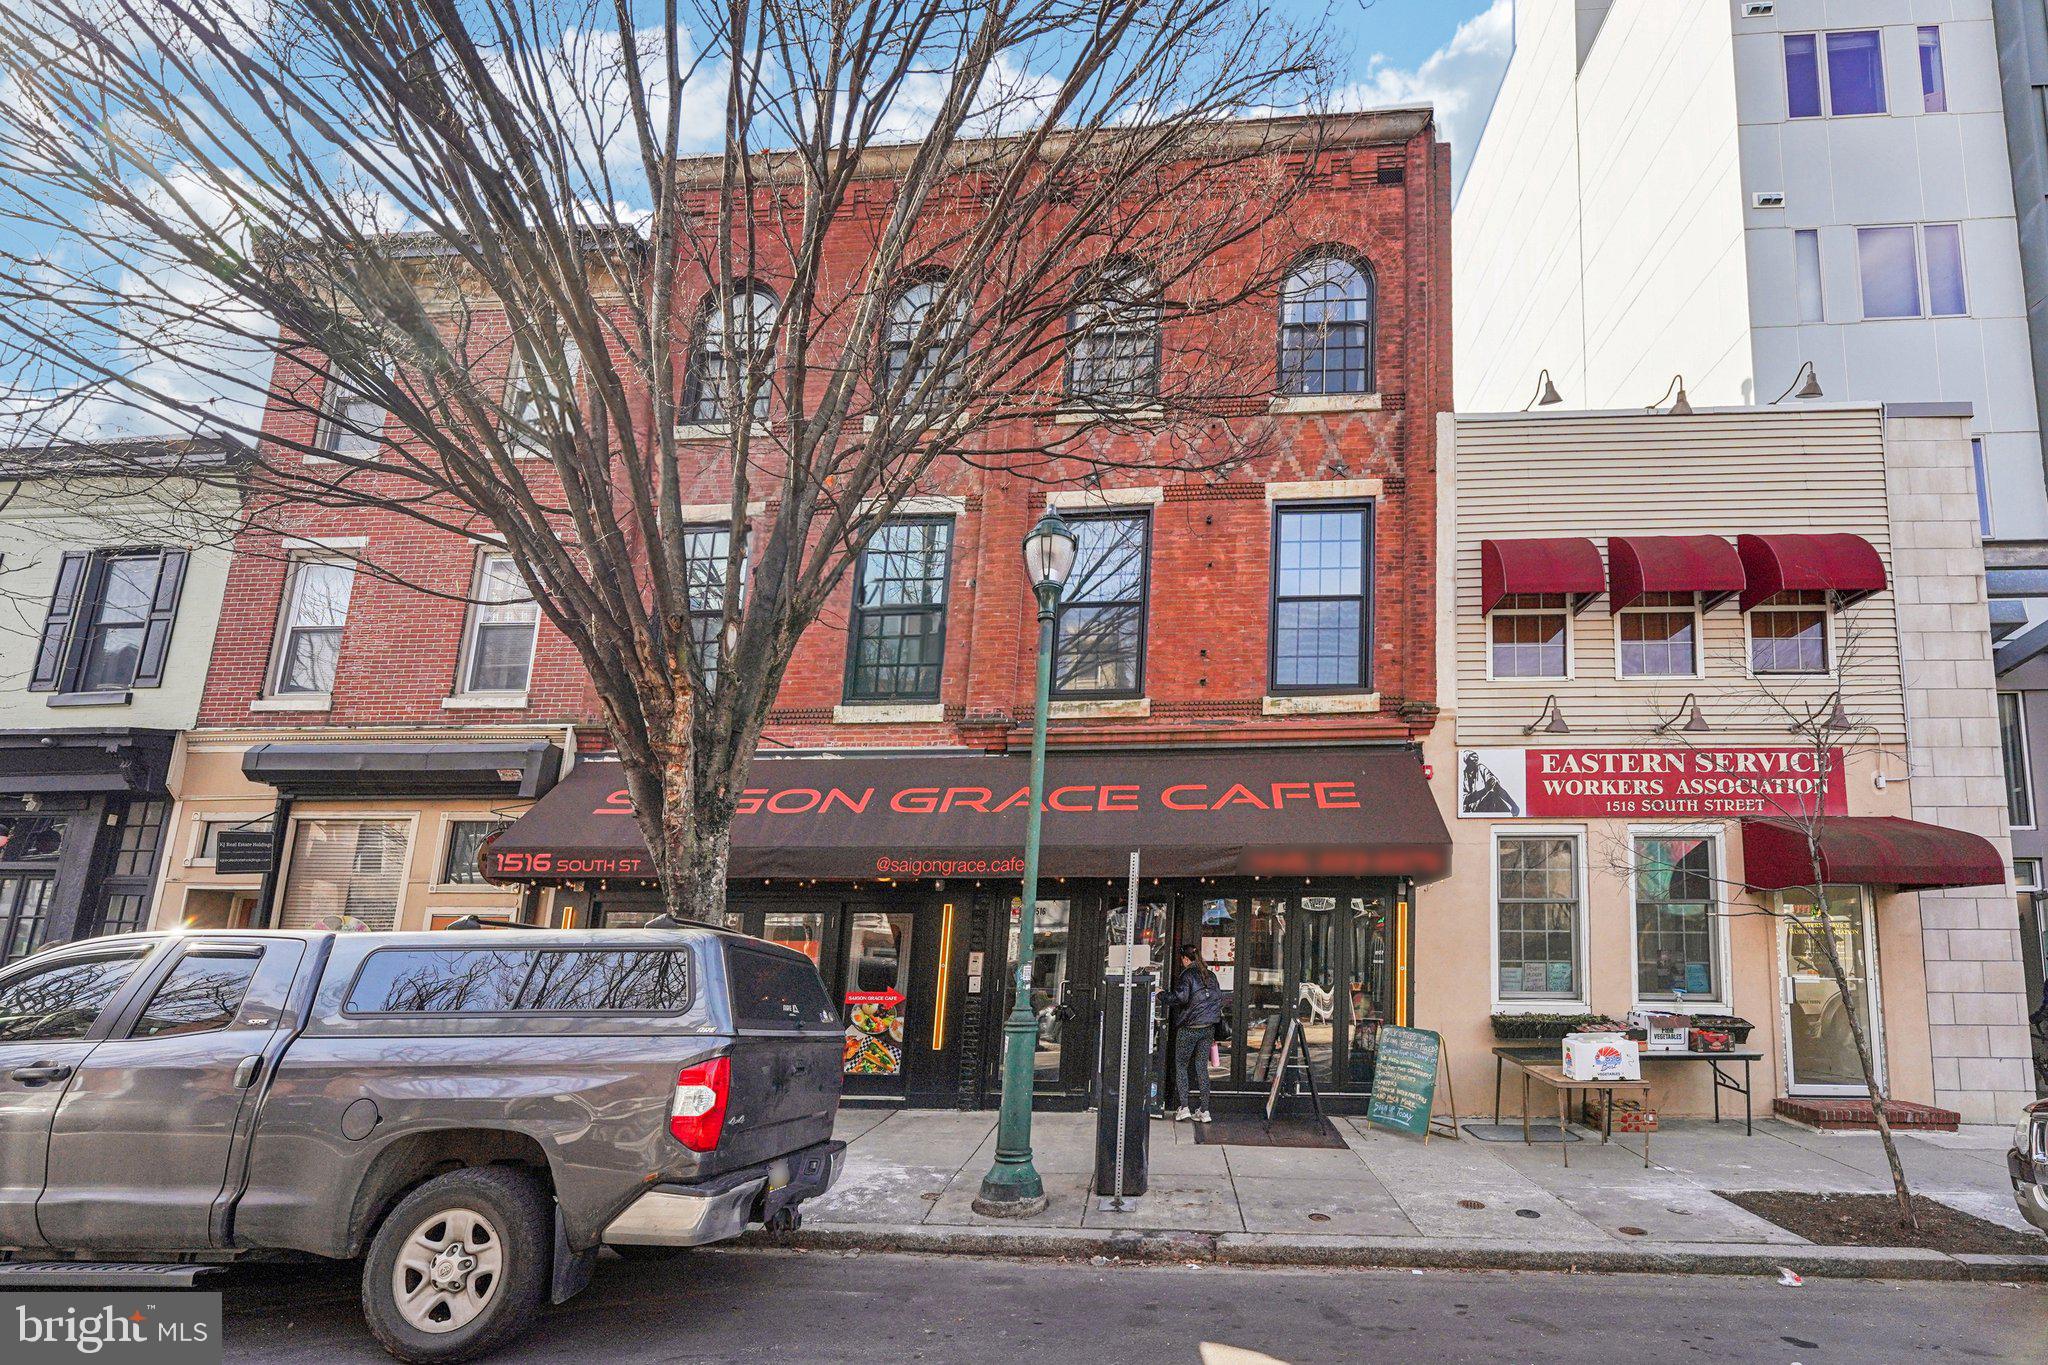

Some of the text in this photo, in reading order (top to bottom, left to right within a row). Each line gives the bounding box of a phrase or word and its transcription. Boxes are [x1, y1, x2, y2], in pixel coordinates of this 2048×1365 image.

[1540, 752, 1832, 774] EASTERN SERVICE
[1542, 778, 1829, 795] WORKERS ASSOCIATION
[593, 781, 1361, 814] SGON GRACE CAFE
[1606, 799, 1765, 812] 1518 SOUTH STREET
[496, 853, 642, 872] 1516 SOUTH ST
[876, 856, 1025, 875] @saigongrace.cafe
